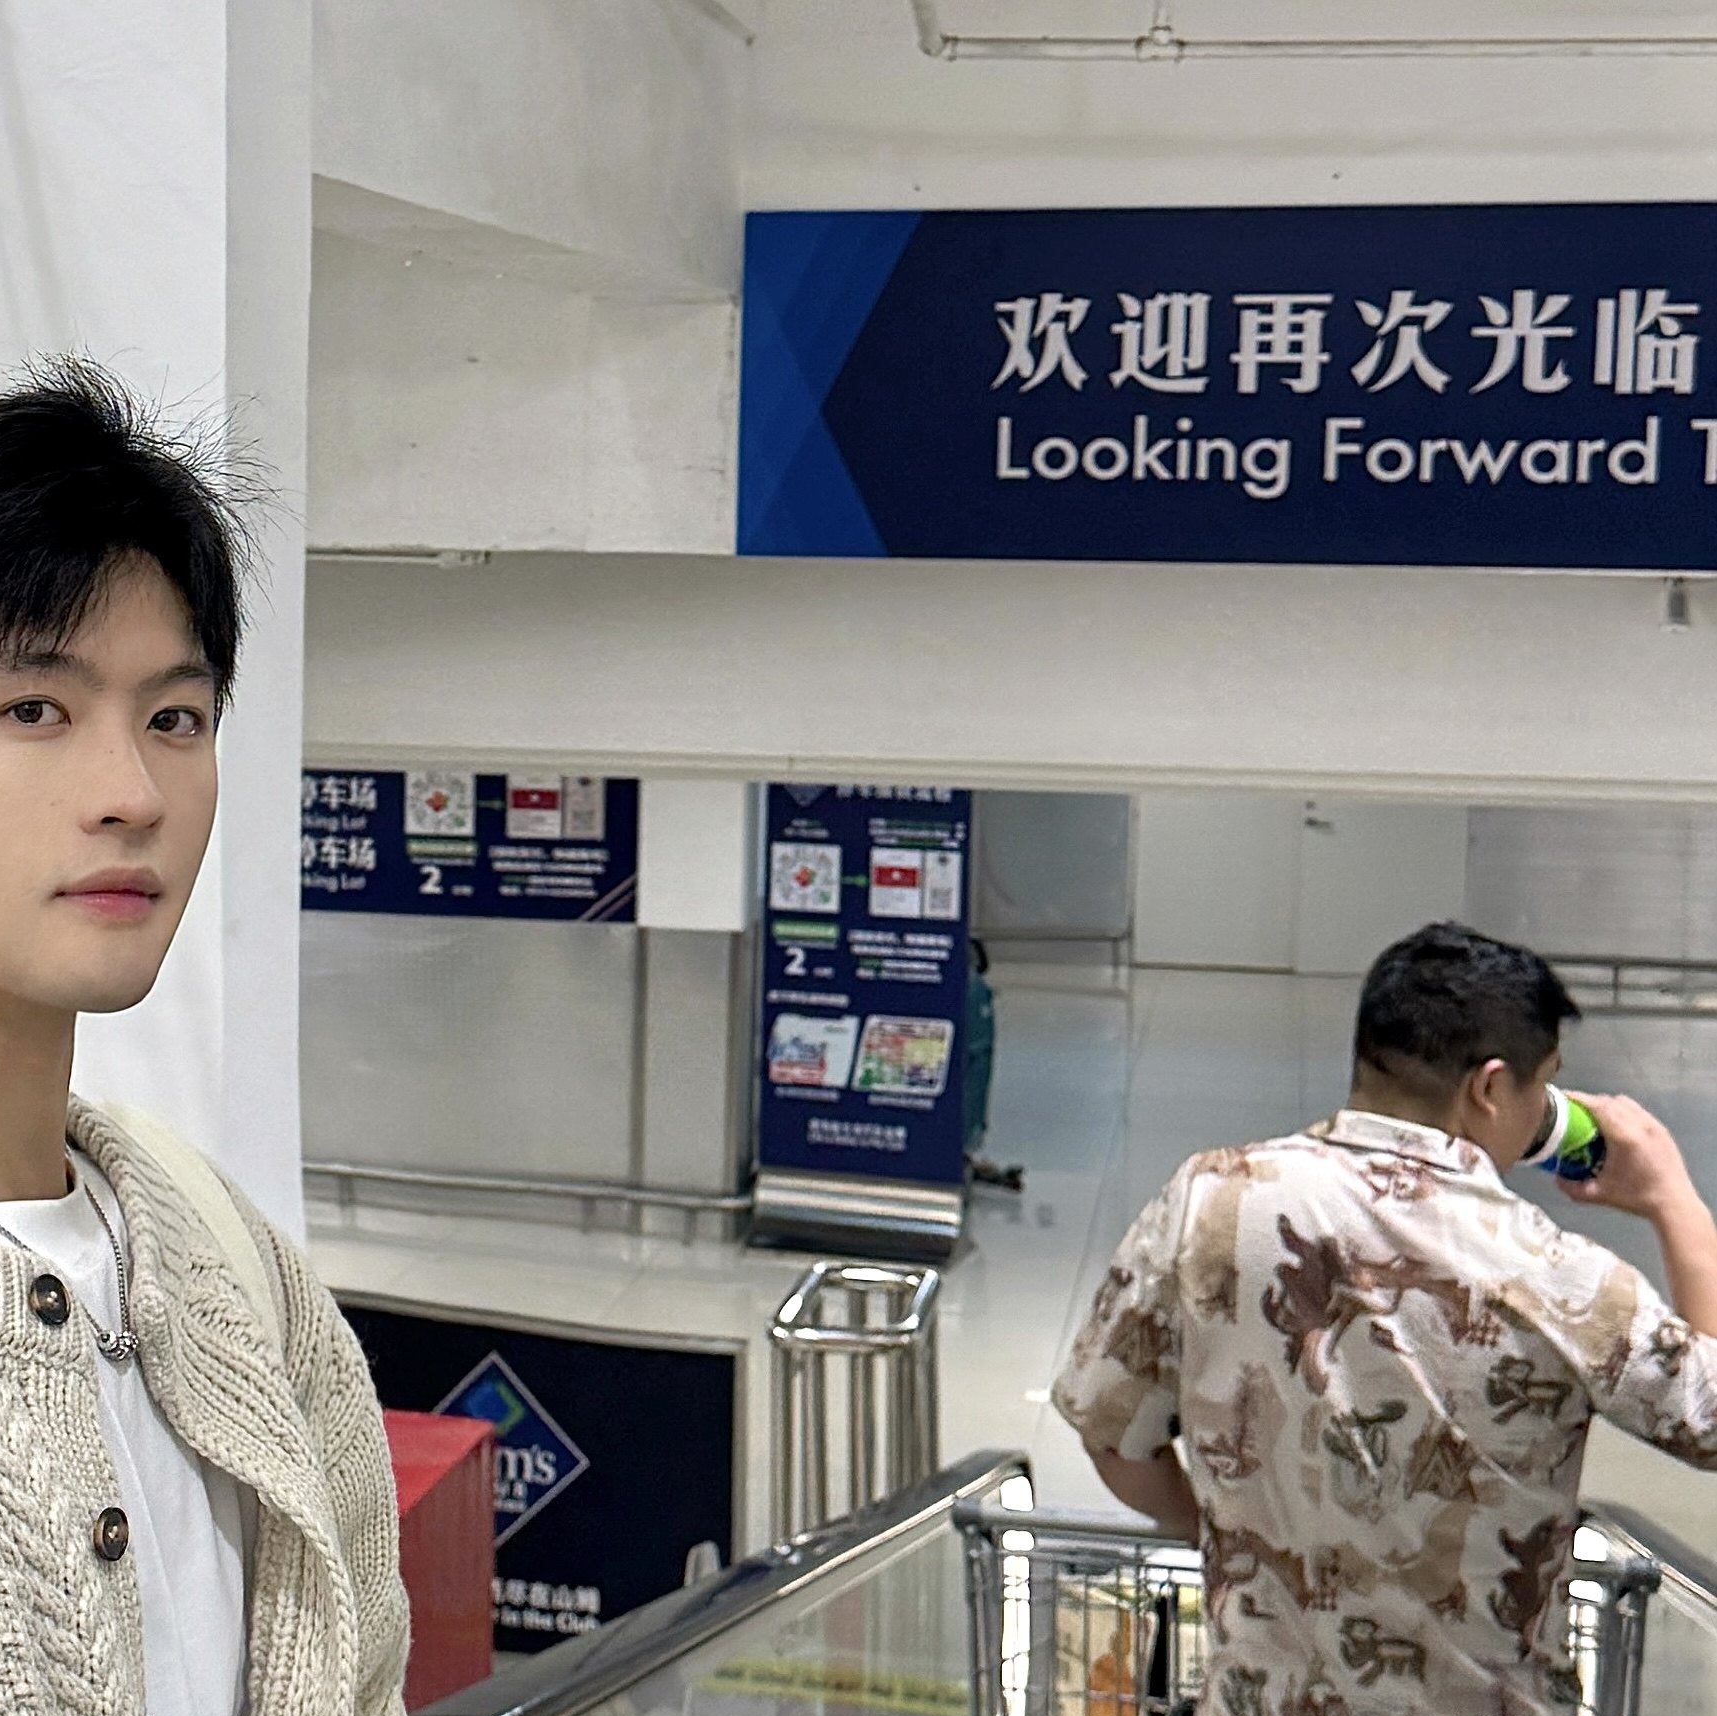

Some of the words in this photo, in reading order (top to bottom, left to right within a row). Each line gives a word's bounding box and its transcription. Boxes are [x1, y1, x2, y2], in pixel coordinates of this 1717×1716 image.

[990, 288, 1699, 395] 欢迎再次光临
[996, 415, 1291, 499] Looking
[1323, 415, 1659, 484] Forward
[785, 947, 806, 976] 2
[493, 1443, 557, 1486] m's
